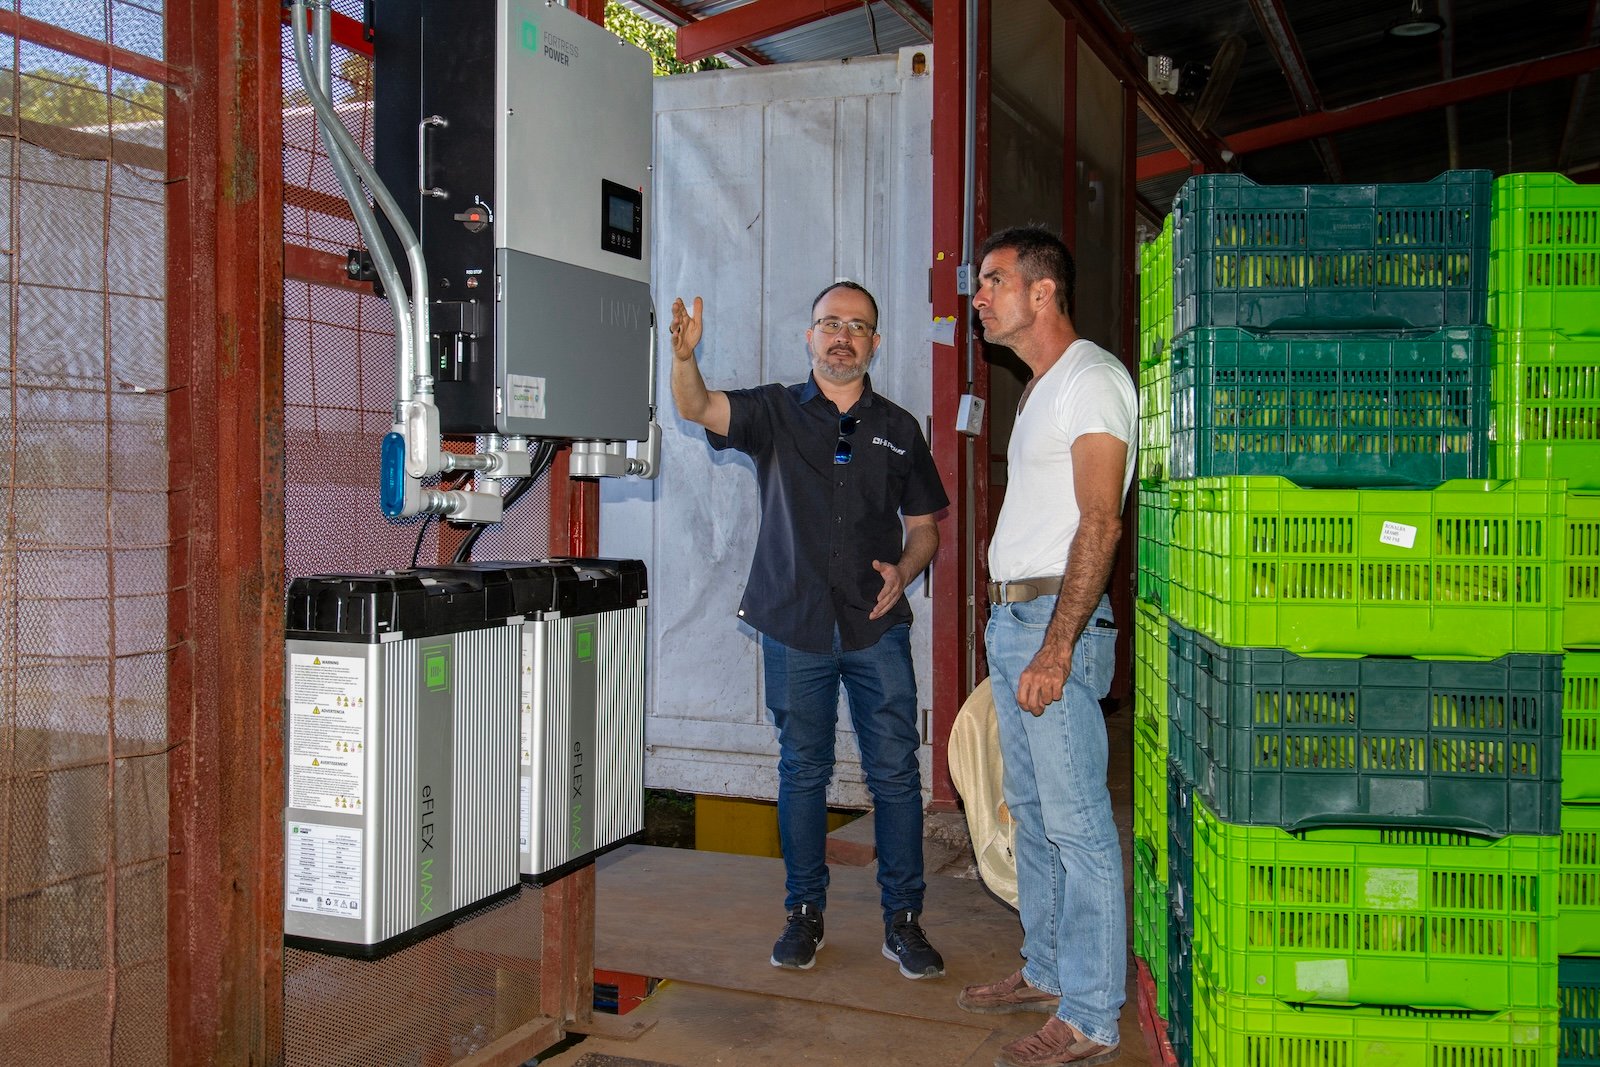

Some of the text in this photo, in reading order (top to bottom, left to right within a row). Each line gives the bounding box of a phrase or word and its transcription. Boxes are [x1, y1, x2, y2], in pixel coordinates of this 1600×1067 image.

[543, 31, 579, 58] FORTRESS
[543, 45, 569, 67] POWER
[571, 741, 583, 854] eFLEX MAX
[420, 785, 434, 917] eFLEX MAX
